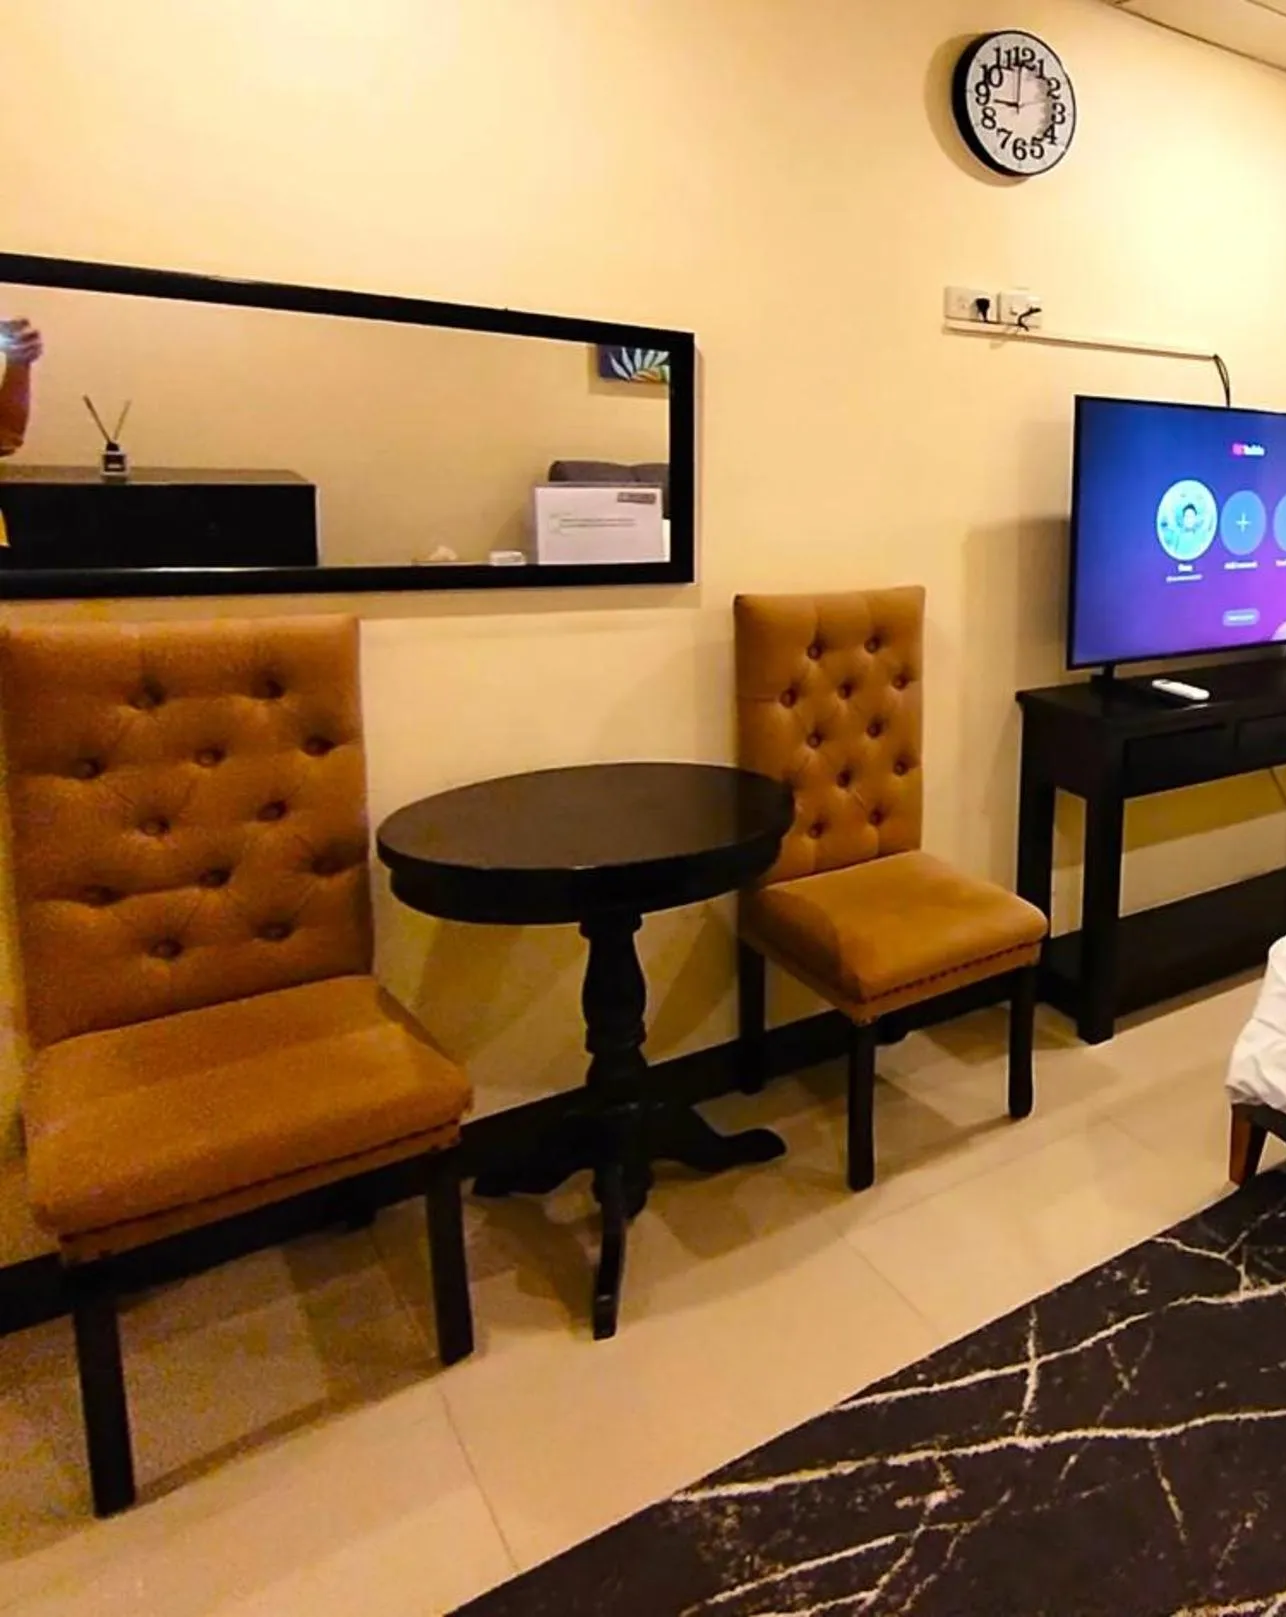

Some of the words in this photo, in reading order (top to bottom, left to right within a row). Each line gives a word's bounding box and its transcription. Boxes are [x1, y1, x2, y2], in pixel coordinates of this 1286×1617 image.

[993, 47, 1014, 71] 11
[1013, 46, 1036, 71] 12
[1036, 59, 1046, 80] 1
[980, 64, 1003, 88] 10
[975, 81, 991, 106] 9
[1047, 77, 1061, 100] 2
[981, 106, 996, 130] 8
[1051, 103, 1065, 125] 3
[996, 127, 1013, 149] 7
[1043, 123, 1058, 145] 4
[1012, 138, 1027, 160] 6
[1030, 136, 1044, 159] 5
